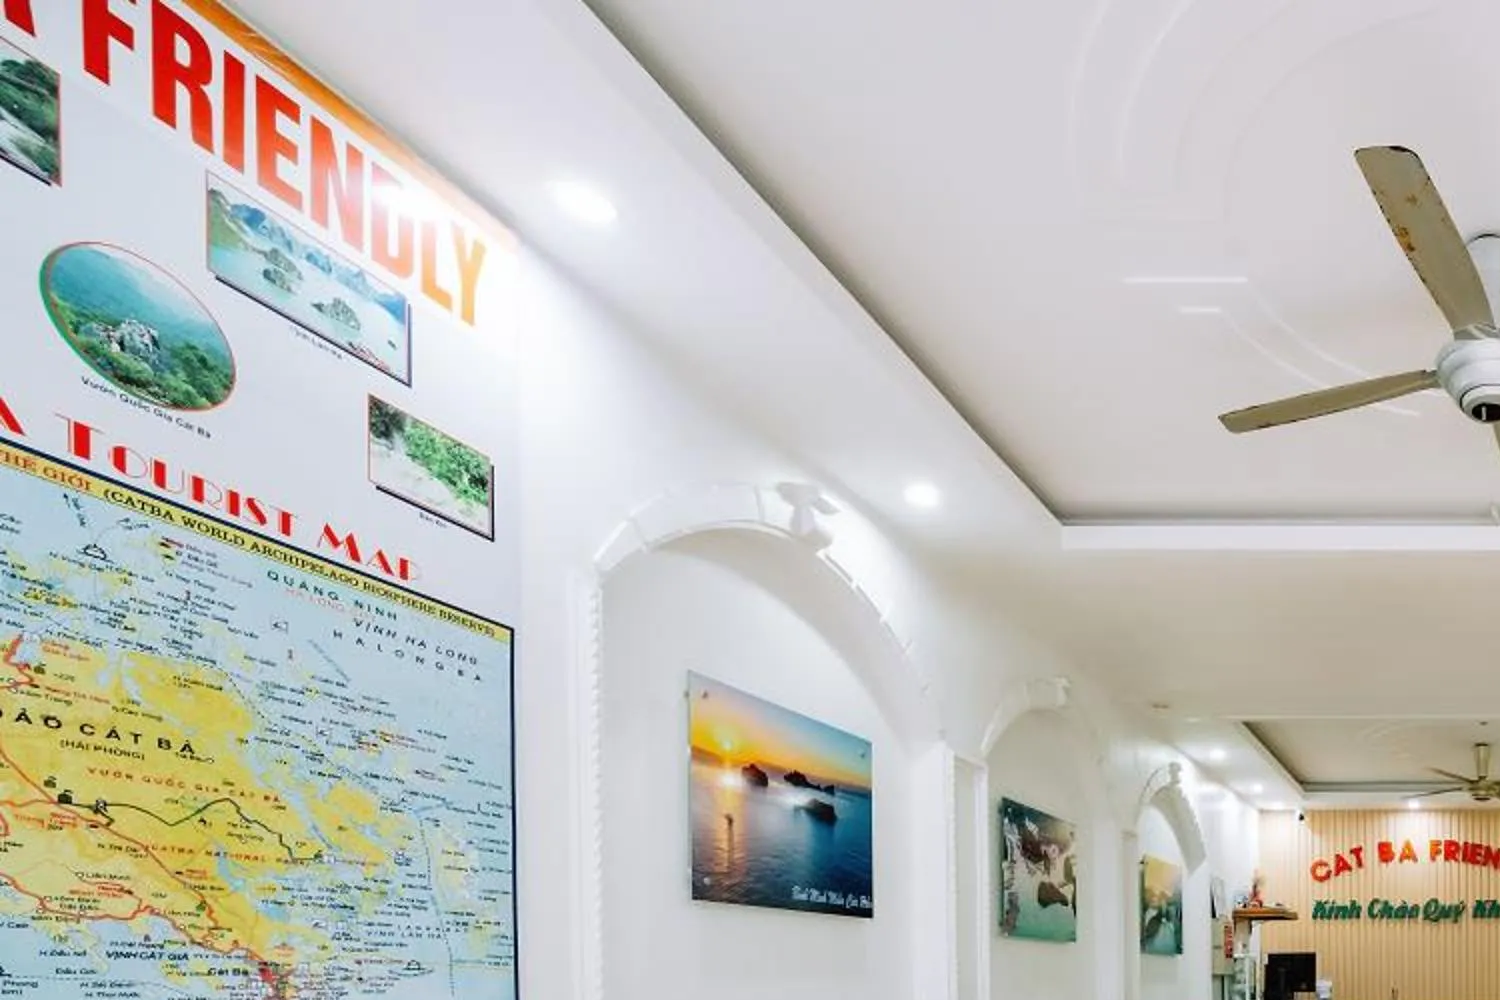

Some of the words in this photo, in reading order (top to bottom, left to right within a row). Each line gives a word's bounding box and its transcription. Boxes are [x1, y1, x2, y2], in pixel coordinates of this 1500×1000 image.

[83, 0, 487, 327] FRIENDLY
[54, 412, 297, 537] TOURIST
[317, 522, 423, 582] MAP
[181, 514, 245, 549] WORLD
[251, 541, 360, 590] ARCHIPELAGO
[363, 582, 438, 616] BIOSPHERE
[354, 600, 397, 621] NINH
[435, 645, 477, 665] LONG
[0, 707, 62, 730] ẢO
[79, 722, 143, 745] CÁT
[1310, 846, 1364, 883] CAT
[1378, 839, 1418, 864] BA
